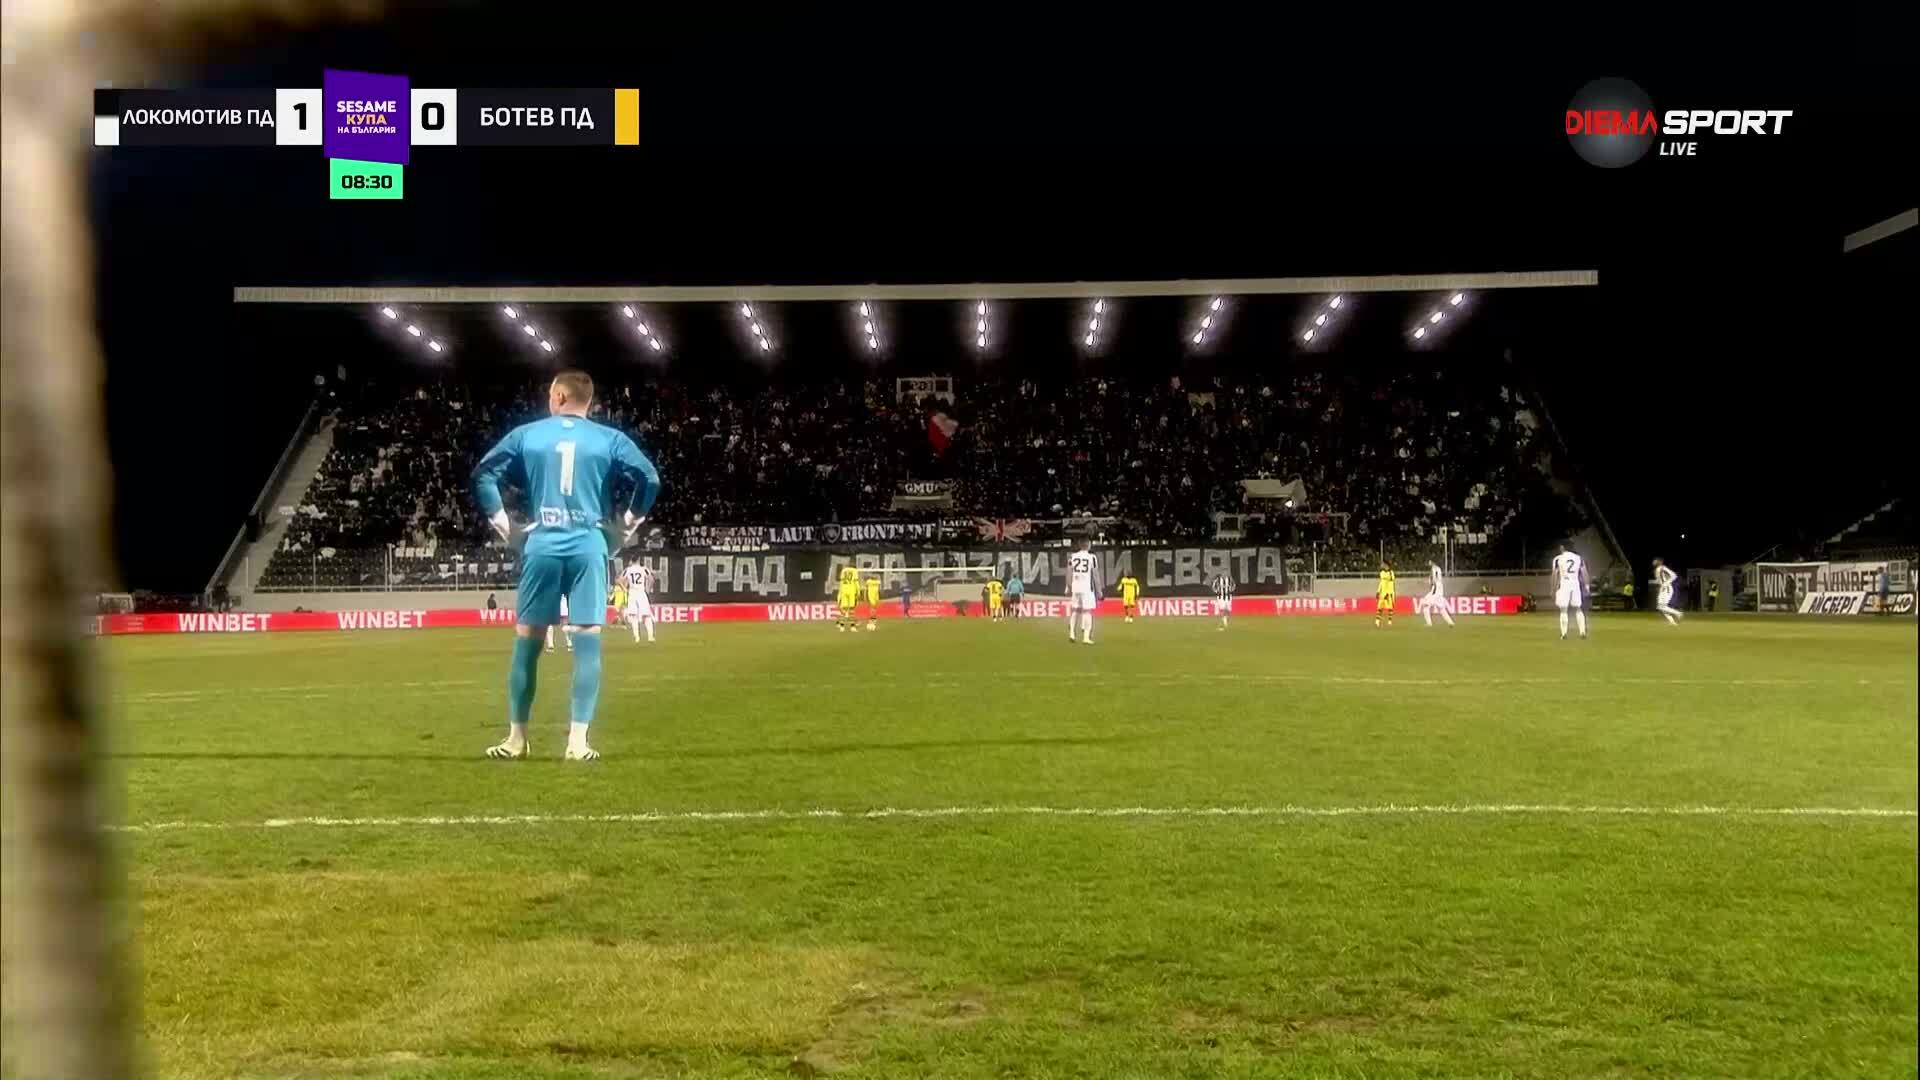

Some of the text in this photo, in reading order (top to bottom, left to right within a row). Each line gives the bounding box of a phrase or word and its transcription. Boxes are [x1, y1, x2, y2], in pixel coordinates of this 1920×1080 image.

[555, 440, 577, 497] 1
[768, 526, 816, 543] LAUT
[682, 554, 788, 597] ГРАД
[1146, 546, 1283, 587] СВЯТА
[1073, 558, 1089, 573] 23
[1566, 559, 1576, 574] 2
[629, 572, 643, 585] 12
[1763, 572, 1812, 598] WINET
[767, 603, 840, 621] WINBE
[1411, 596, 1500, 615] WNBET
[177, 612, 272, 633] WINBET
[337, 610, 427, 629] WINBET
